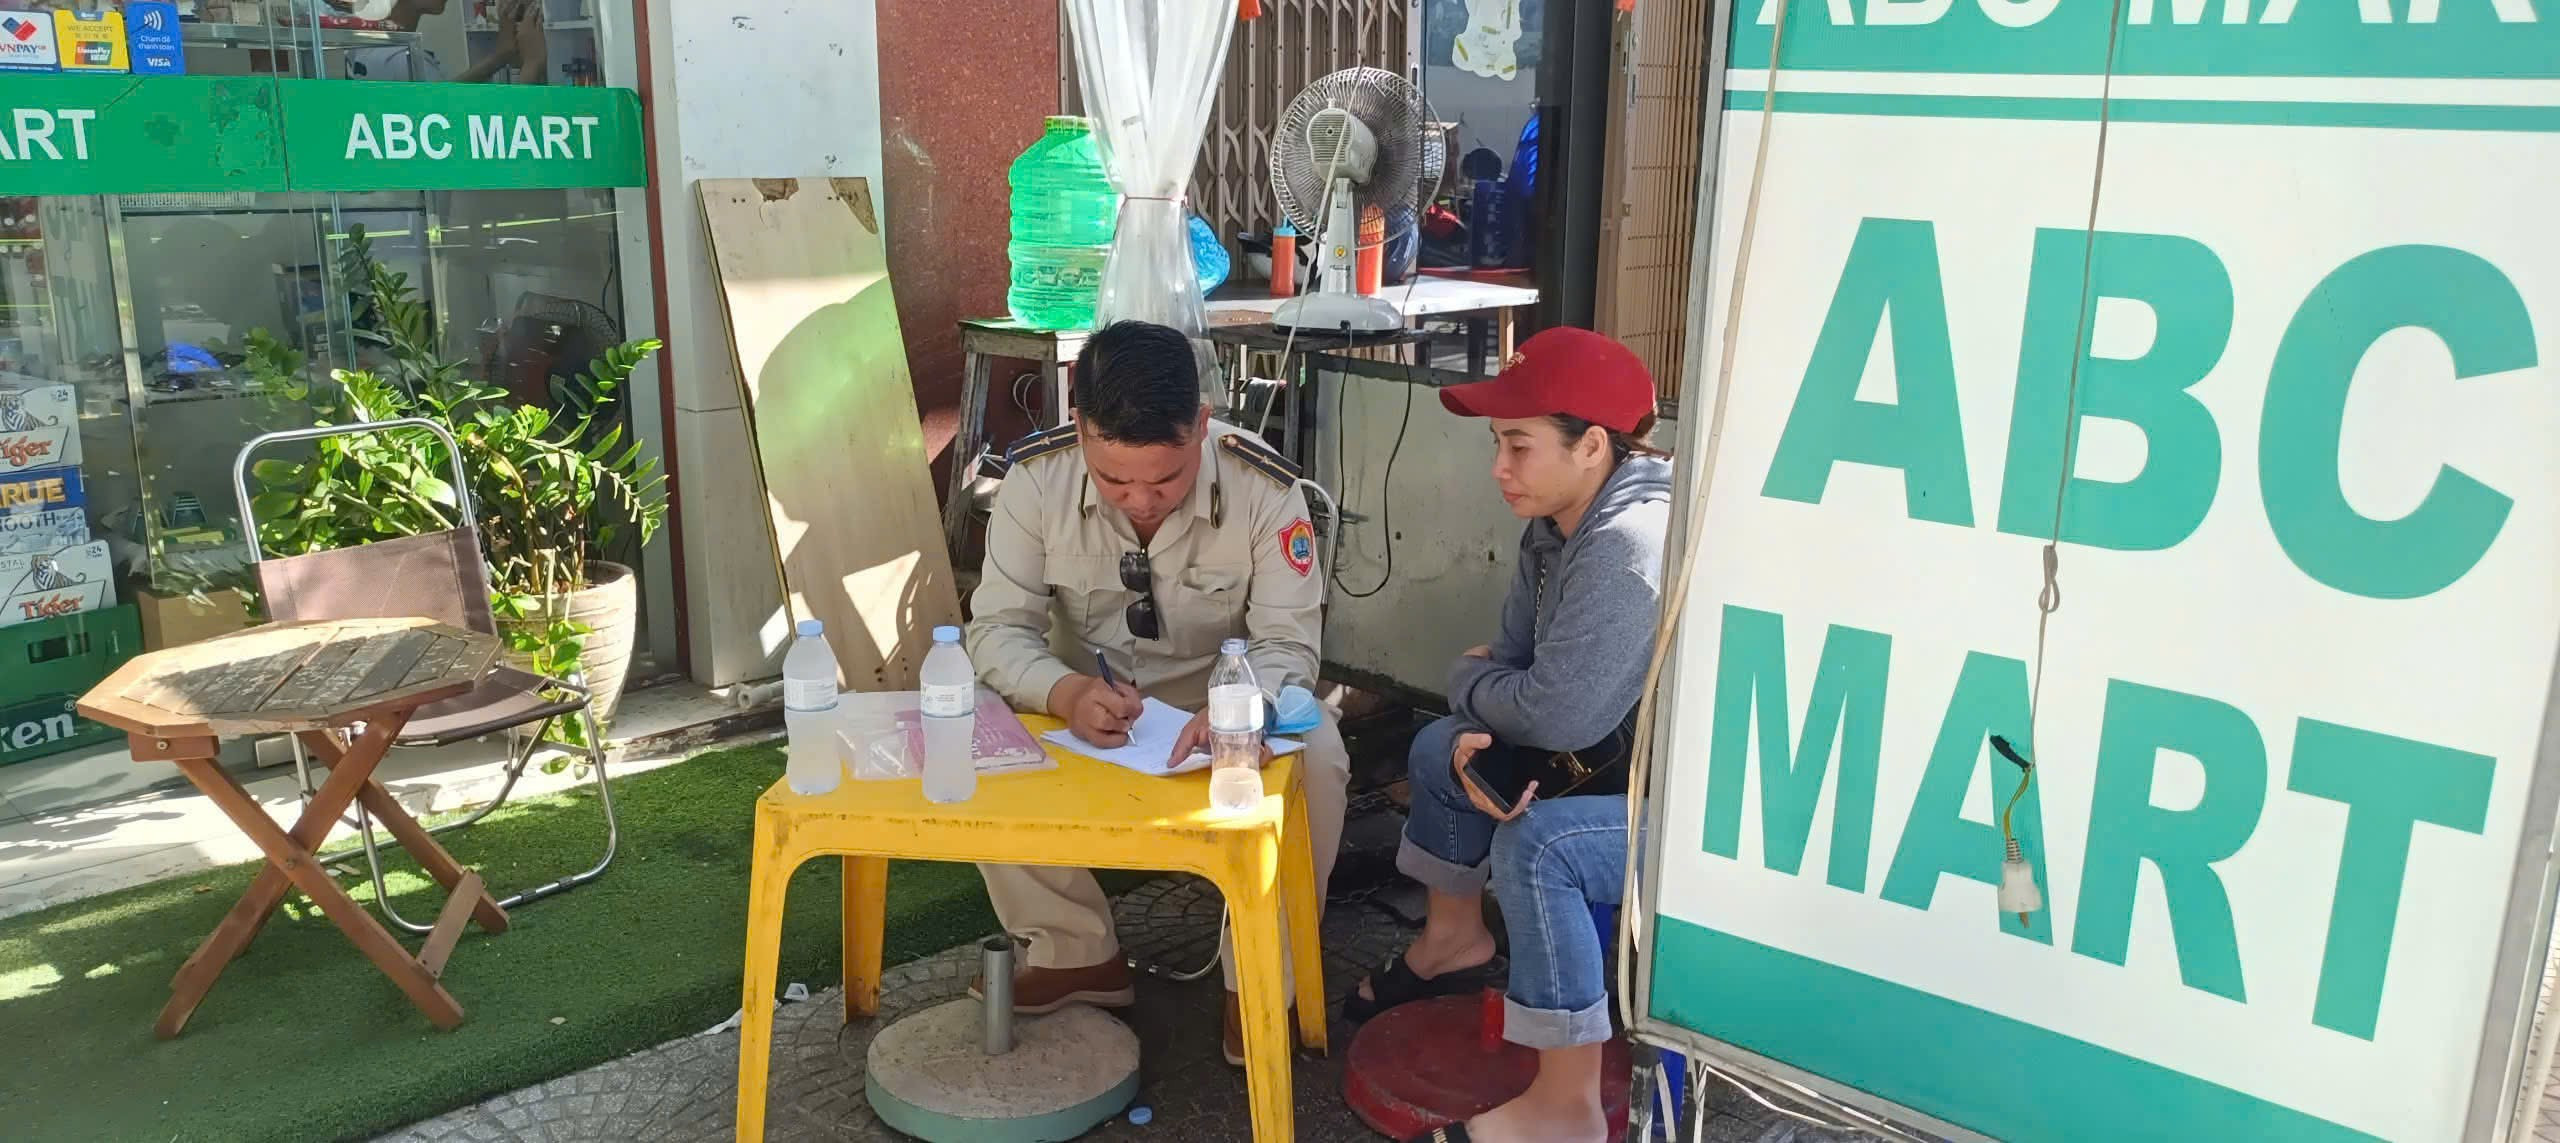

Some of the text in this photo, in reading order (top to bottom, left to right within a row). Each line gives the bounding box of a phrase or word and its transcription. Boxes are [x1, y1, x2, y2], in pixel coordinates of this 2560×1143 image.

[146, 57, 171, 67] VISA
[0, 108, 96, 160] RT
[344, 112, 599, 160] ABC MART
[1760, 216, 2540, 600] ABC
[0, 435, 54, 467] iger
[0, 511, 56, 532] OOTH
[18, 593, 84, 620] Tiger
[1701, 603, 2498, 1043] MART
